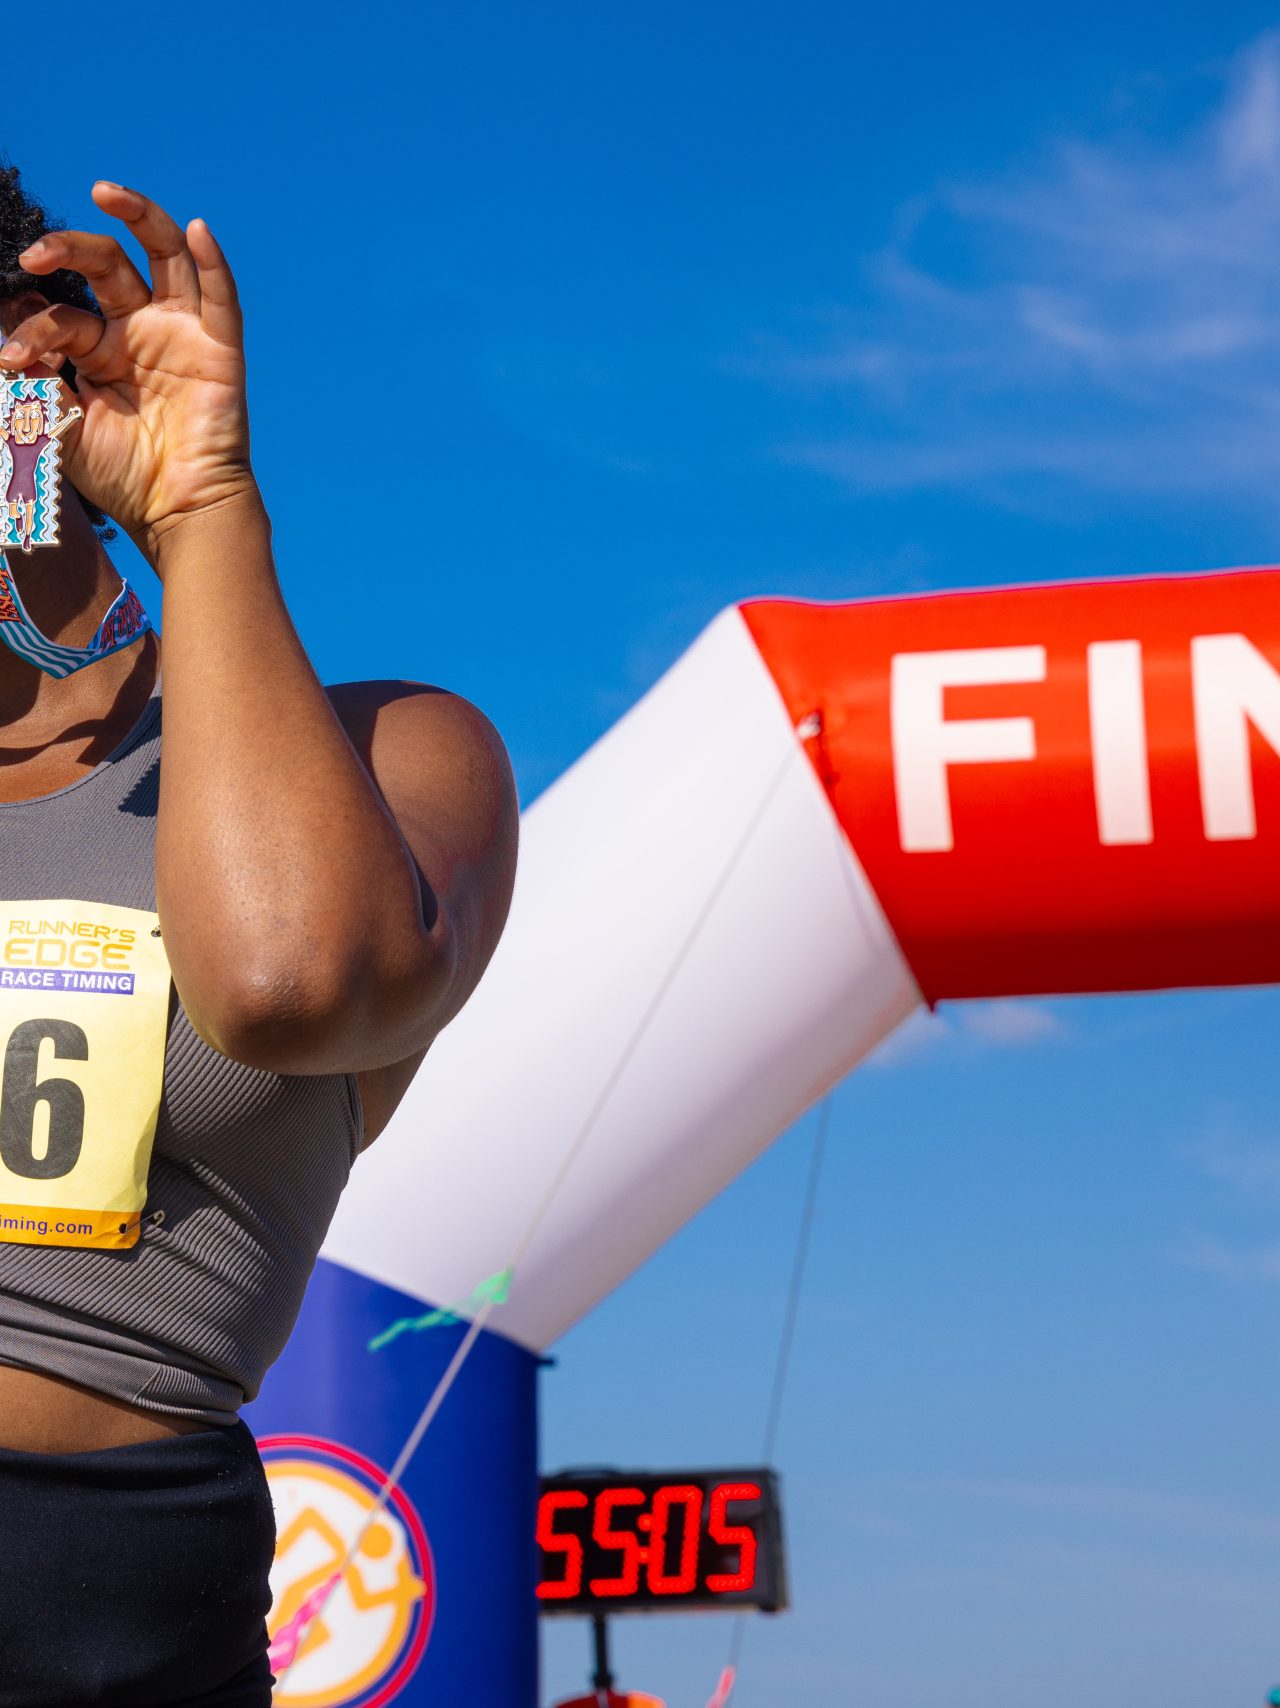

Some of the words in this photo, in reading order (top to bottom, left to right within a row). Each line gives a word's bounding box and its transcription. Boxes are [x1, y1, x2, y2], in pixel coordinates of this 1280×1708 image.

[8, 920, 136, 943] RUNNER'S
[4, 938, 134, 970] EDGE
[1, 971, 55, 987] RACE
[61, 973, 132, 991] TIMING
[535, 1482, 762, 1600] 55:05
